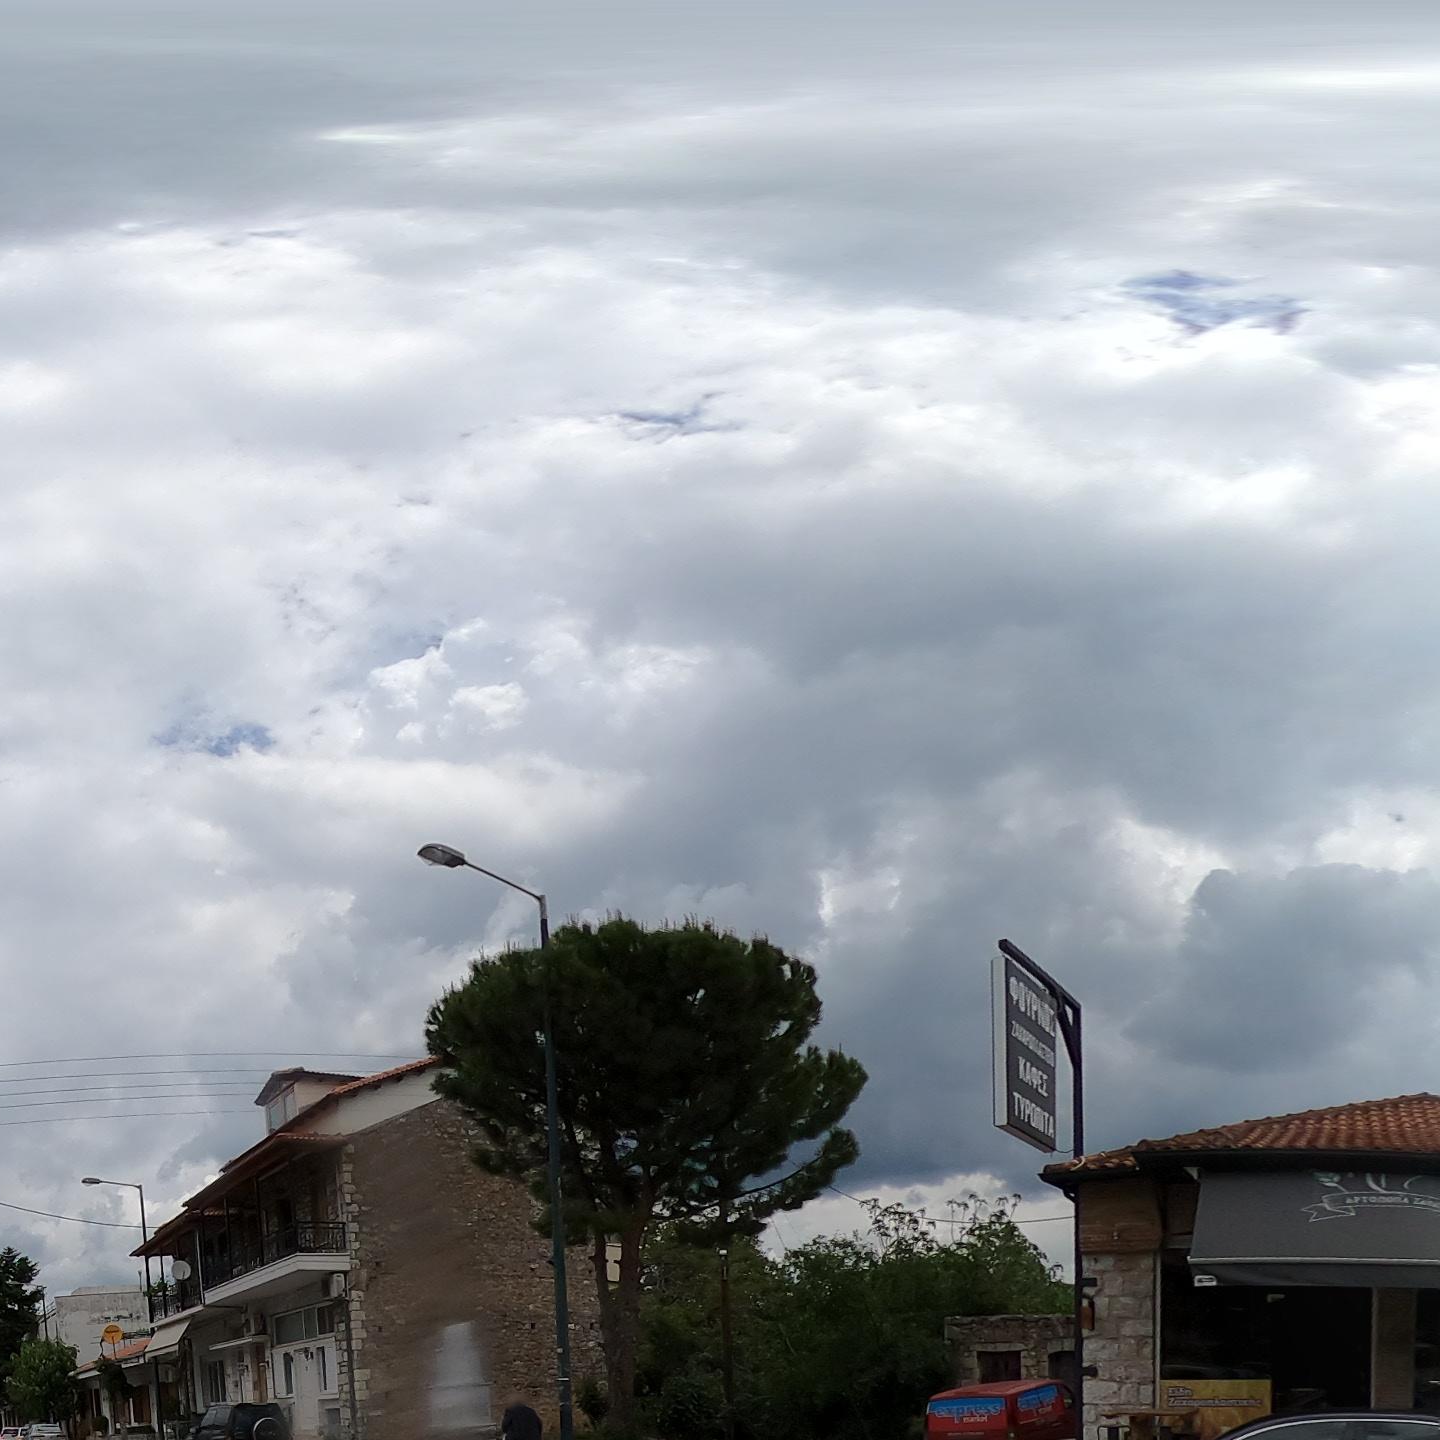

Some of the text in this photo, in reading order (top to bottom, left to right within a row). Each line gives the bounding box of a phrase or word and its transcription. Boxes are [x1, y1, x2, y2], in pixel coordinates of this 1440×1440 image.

[1009, 976, 1056, 1037] ΦΟΥΡΝΟΣ
[1017, 1055, 1049, 1098] ΚΑΦΕΣ
[1012, 1091, 1055, 1138] ΤΥΡΟΠΙΤΑ
[935, 1403, 1002, 1424] express
